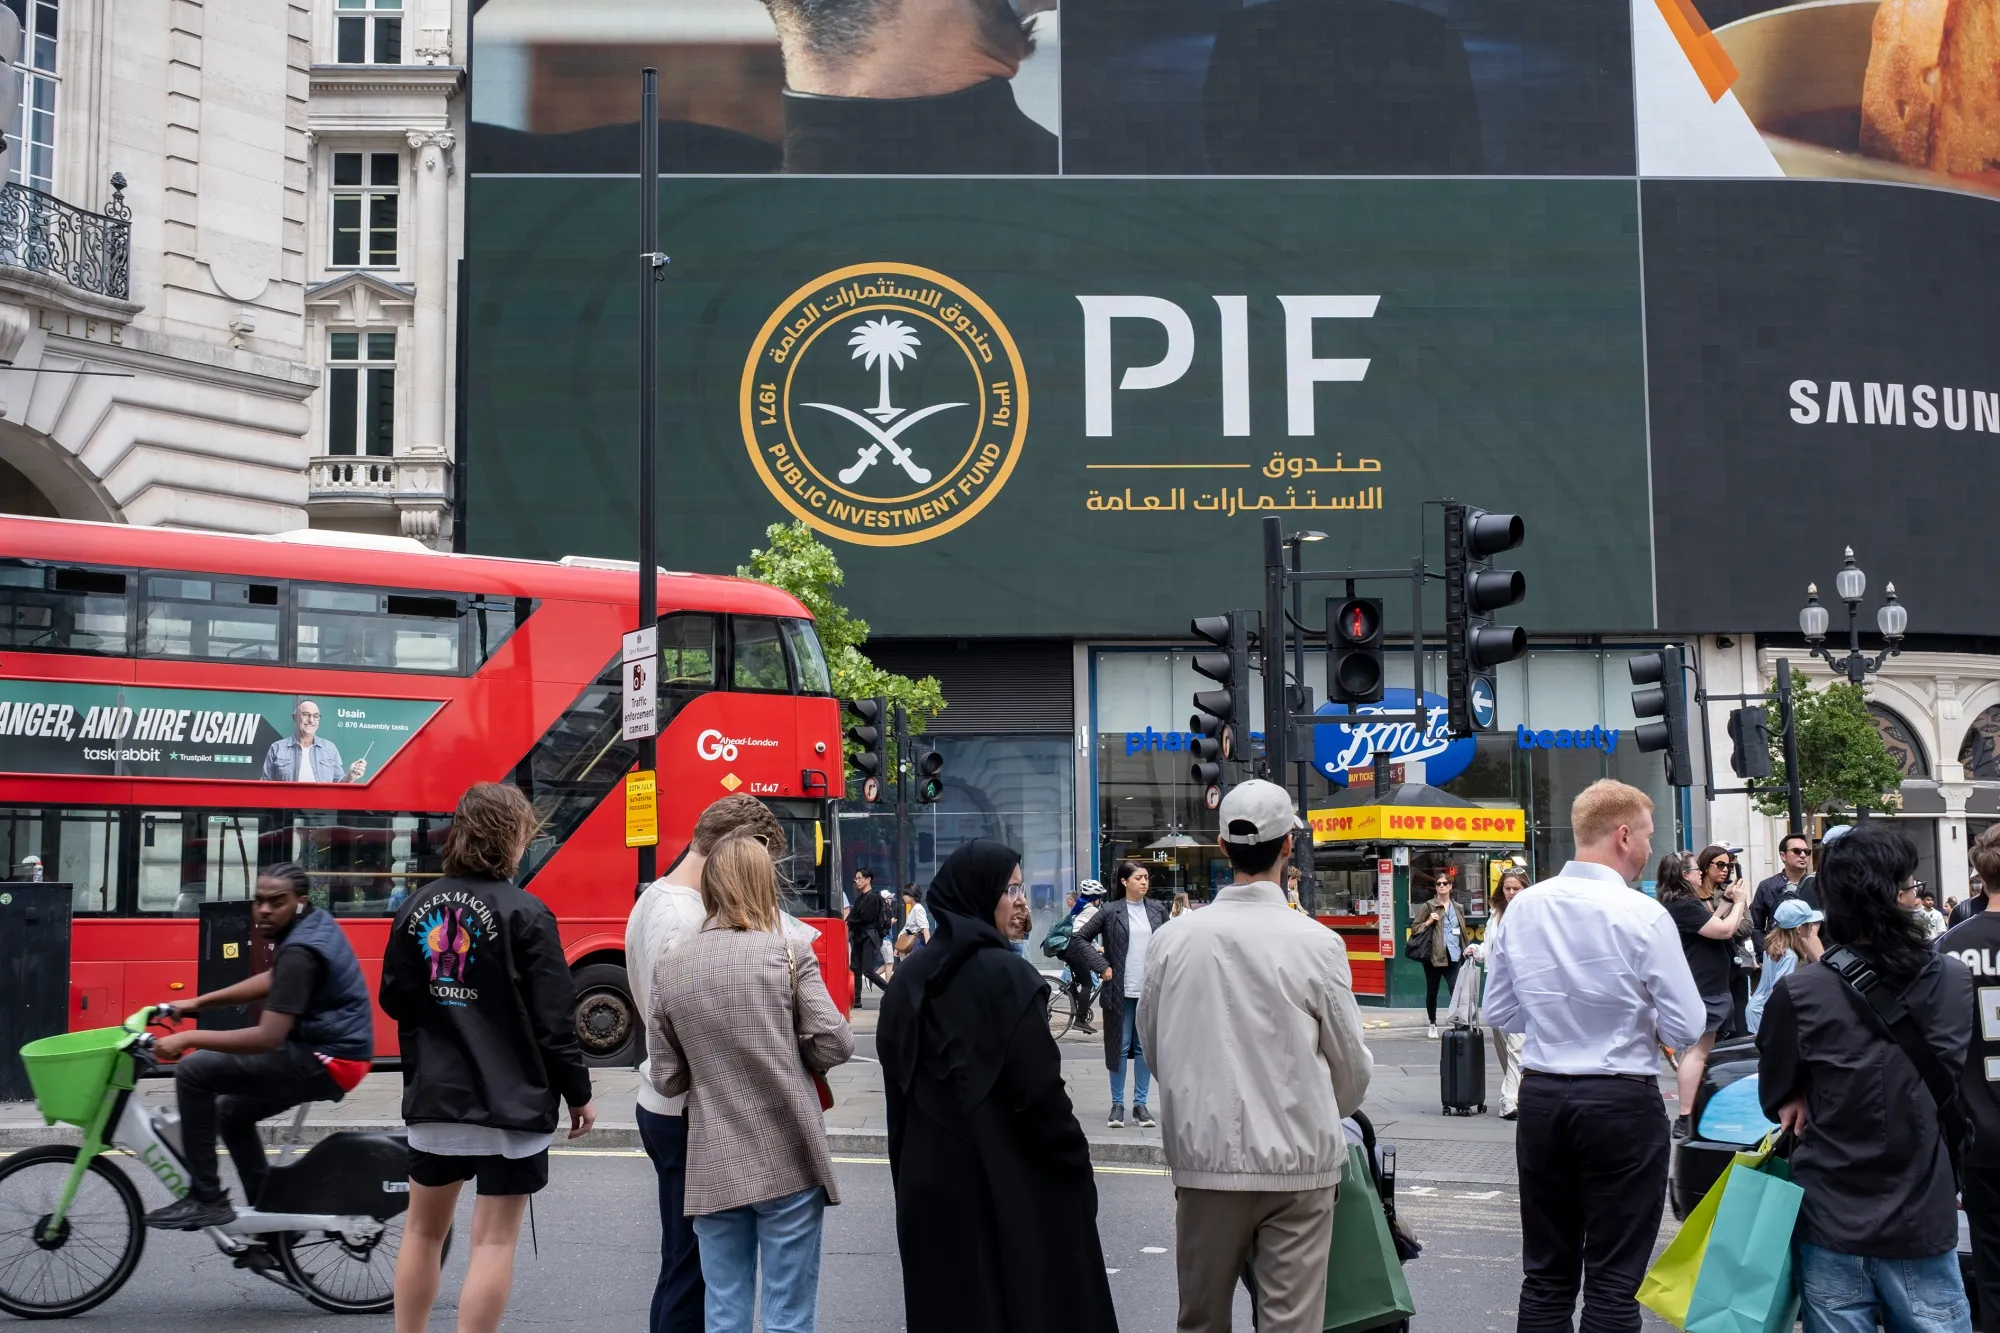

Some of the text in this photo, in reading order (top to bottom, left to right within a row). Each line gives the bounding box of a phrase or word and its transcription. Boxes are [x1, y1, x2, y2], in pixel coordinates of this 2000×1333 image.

[769, 303, 821, 364] العامة
[940, 303, 993, 364] صندوق
[1075, 295, 1381, 436] PIF
[759, 382, 777, 426] 1971
[1262, 451, 1382, 479] صندوق
[768, 442, 1001, 528] PUBLIC INVESTMENT FUND
[1086, 487, 1185, 511] العامة
[631, 696, 647, 708] Traffic
[338, 708, 366, 718] Usain
[624, 708, 654, 722] enforcement
[0, 702, 261, 745] ANGER, AND HIRE USAIN
[359, 722, 390, 731] Assembly
[628, 723, 650, 734] cameras
[696, 728, 738, 762] Go
[720, 736, 778, 746] Ahead-London
[1517, 724, 1619, 754] beauty
[83, 746, 161, 762] taskrabbit
[180, 753, 212, 762] Trustpilot
[1348, 773, 1358, 782] BUY
[1360, 772, 1376, 780] TICKE
[641, 782, 652, 790] JULY
[750, 782, 779, 792] LT447
[1310, 816, 1353, 832] OG SPOT
[1390, 815, 1516, 832] HOT DOG SPOT
[1152, 850, 1168, 862] Lift
[408, 892, 498, 942] DEUS EX MACHINA
[428, 984, 478, 1000] CORDS
